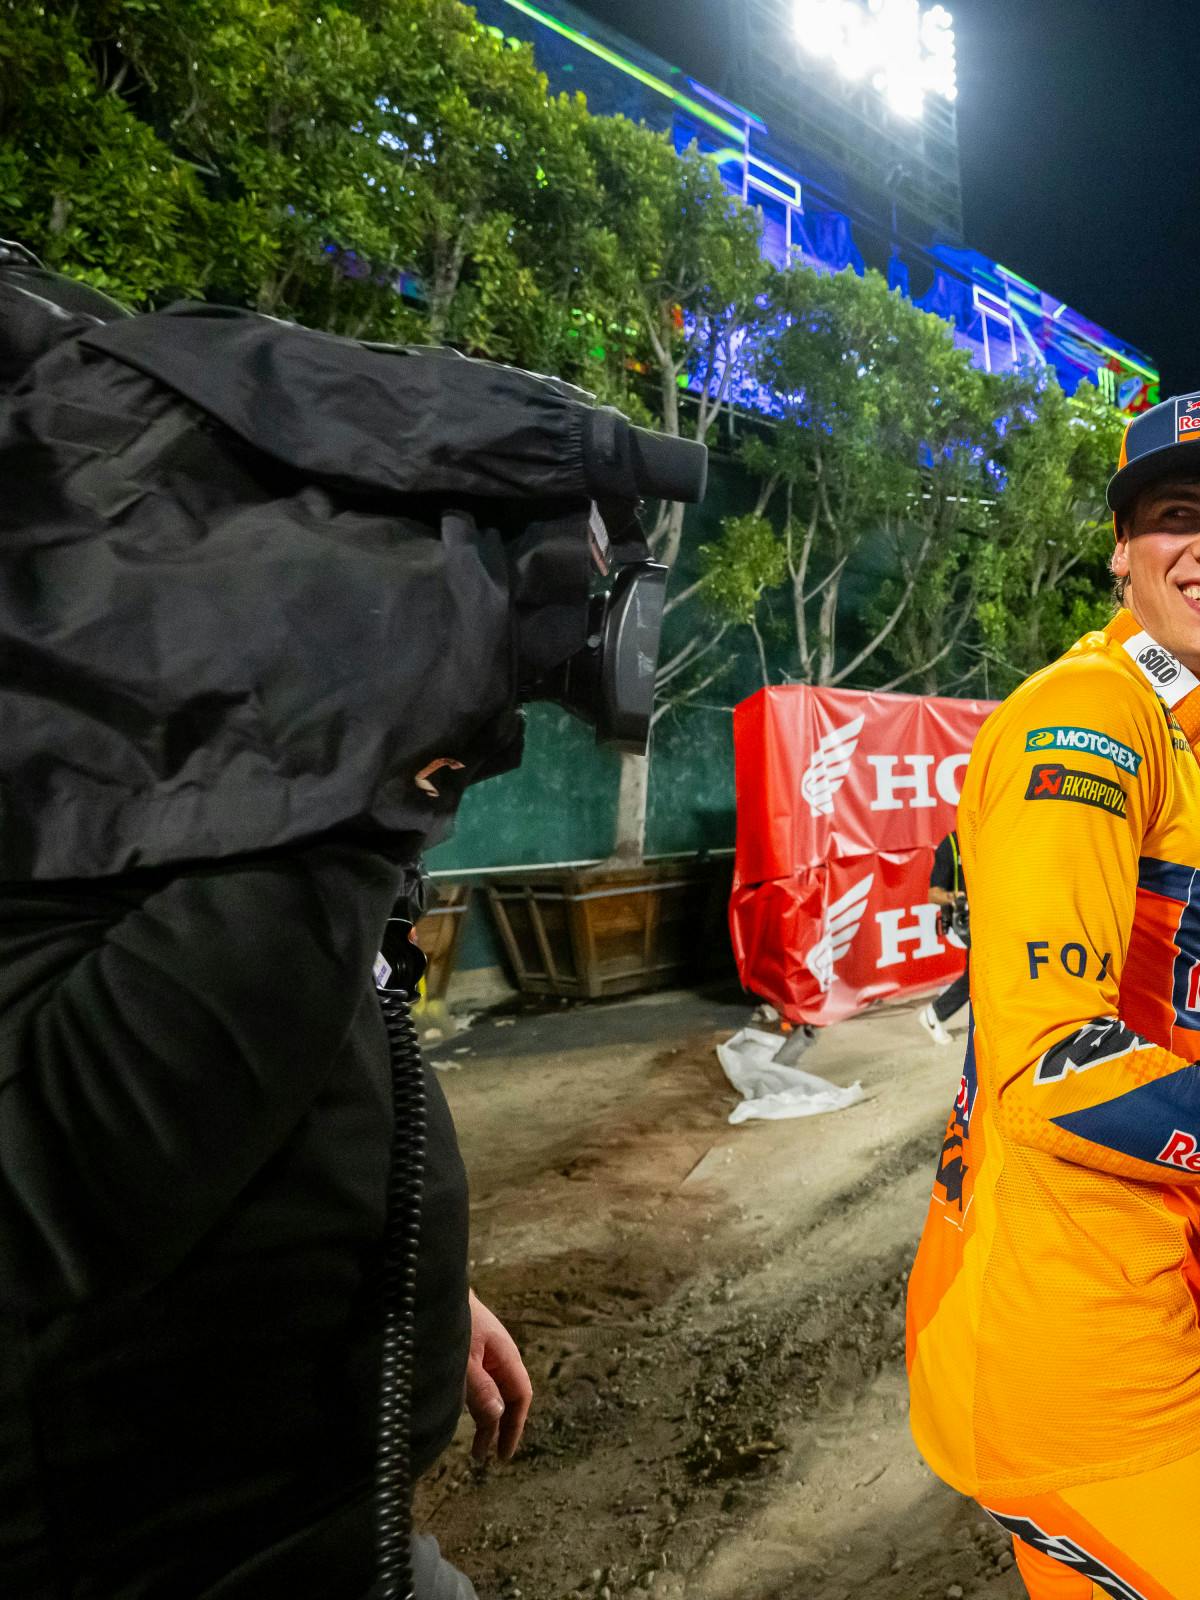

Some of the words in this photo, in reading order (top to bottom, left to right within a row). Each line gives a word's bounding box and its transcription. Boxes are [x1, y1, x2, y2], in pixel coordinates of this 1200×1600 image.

[1138, 648, 1178, 684] SOLO
[1055, 728, 1138, 773] MOTOREX
[1026, 940, 1113, 982] FOX
